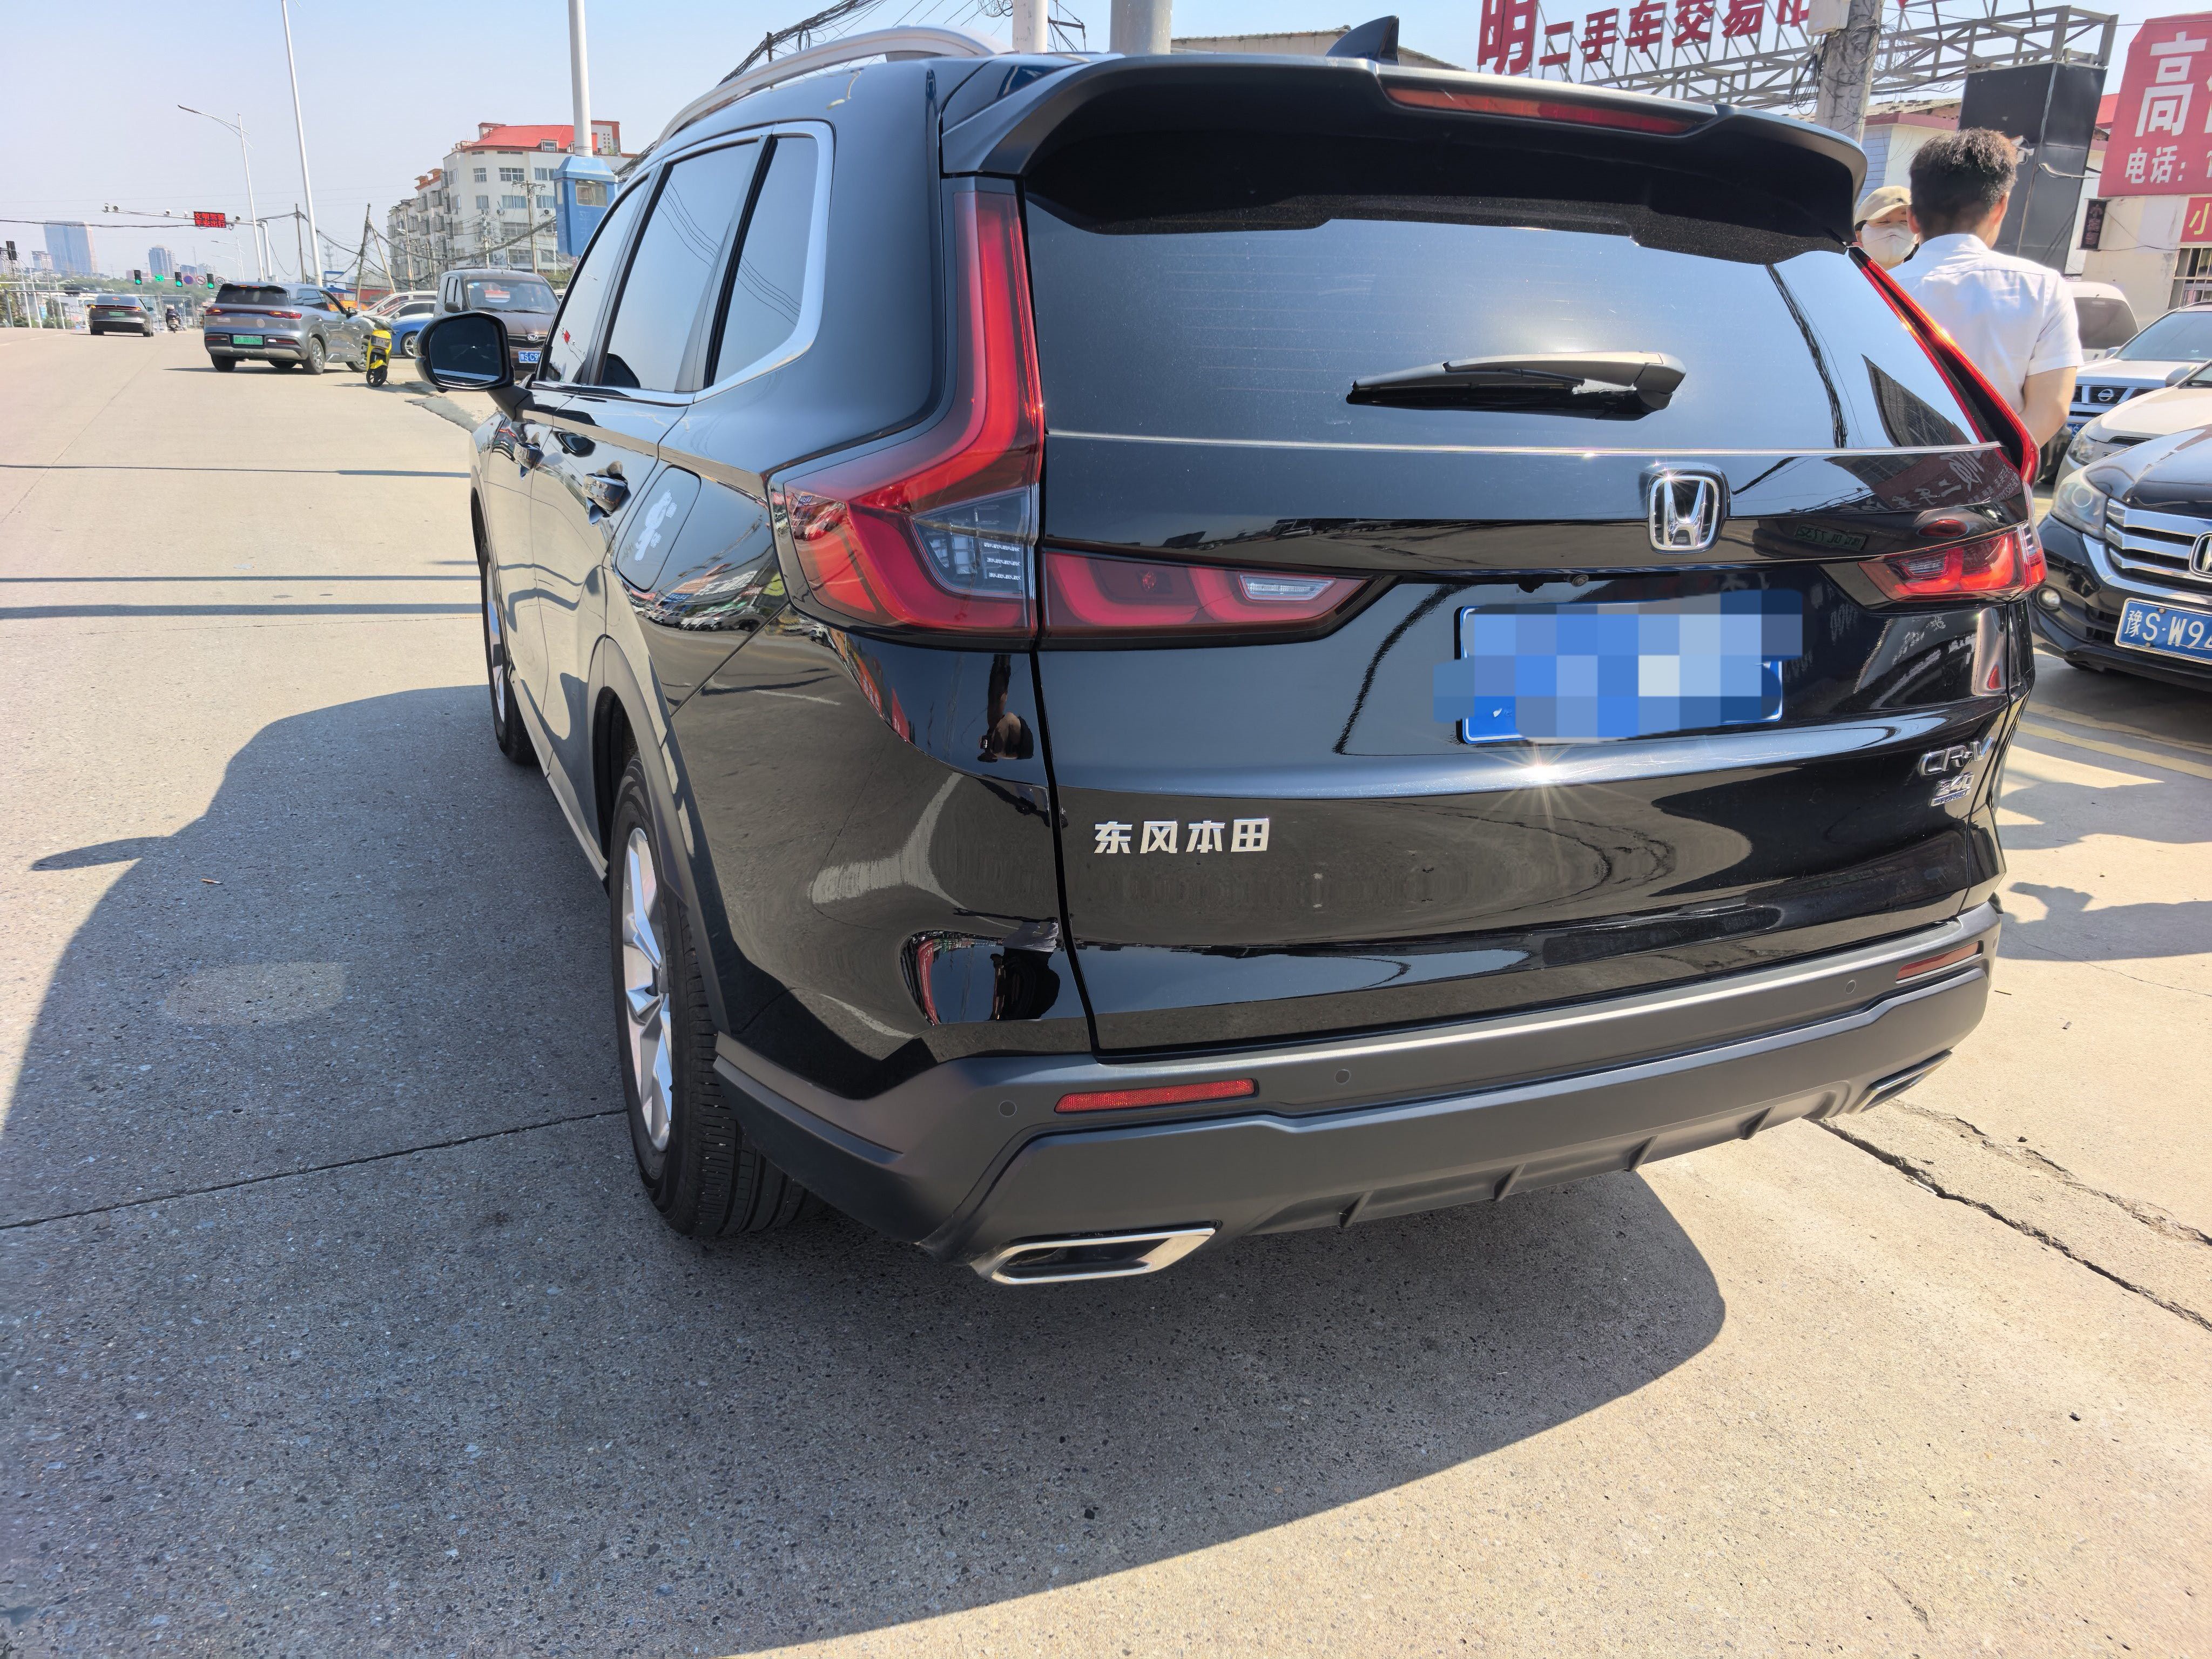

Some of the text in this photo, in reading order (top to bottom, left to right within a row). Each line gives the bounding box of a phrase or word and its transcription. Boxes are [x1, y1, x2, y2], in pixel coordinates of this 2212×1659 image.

[2135, 31, 2212, 138] 高
[195, 219, 226, 227] 平安出行
[1918, 737, 1994, 775] CR-V
[1094, 818, 1270, 854] 东风本田
